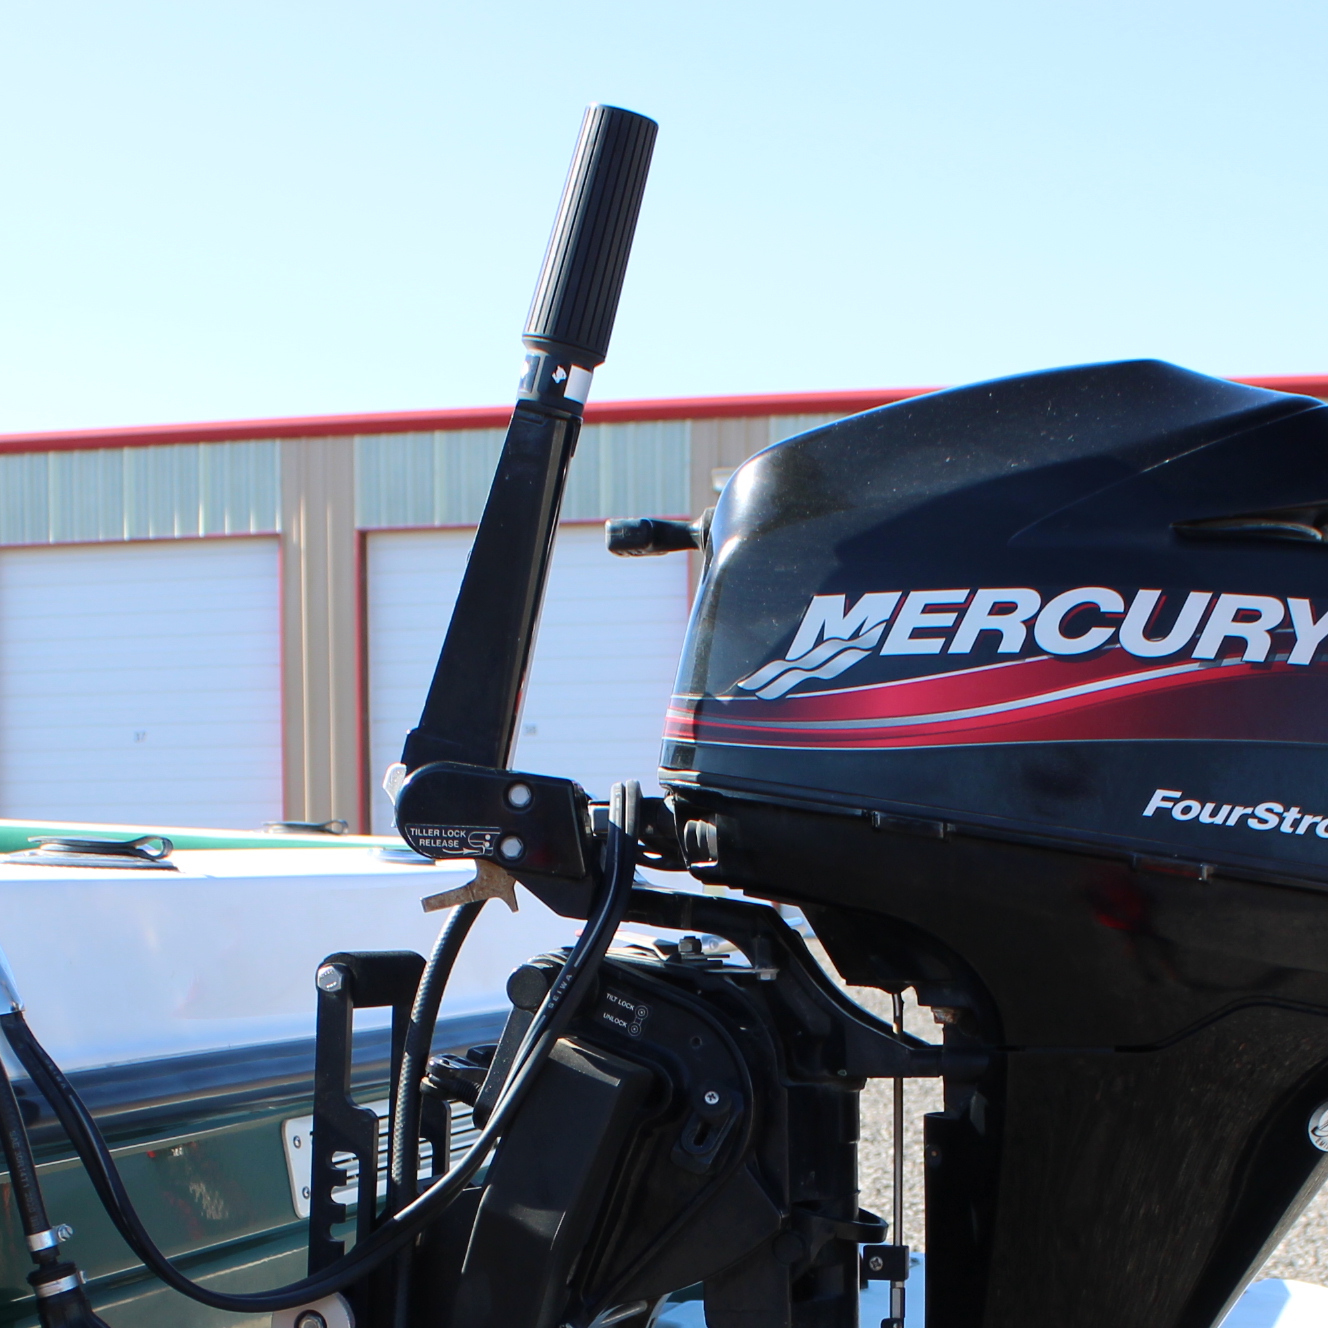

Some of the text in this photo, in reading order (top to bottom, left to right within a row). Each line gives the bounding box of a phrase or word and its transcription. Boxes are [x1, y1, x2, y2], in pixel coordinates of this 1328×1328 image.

[410, 827, 466, 838] TILLER LOCK
[419, 838, 459, 848] RELEASE
[606, 992, 635, 1011] TILT LOCK
